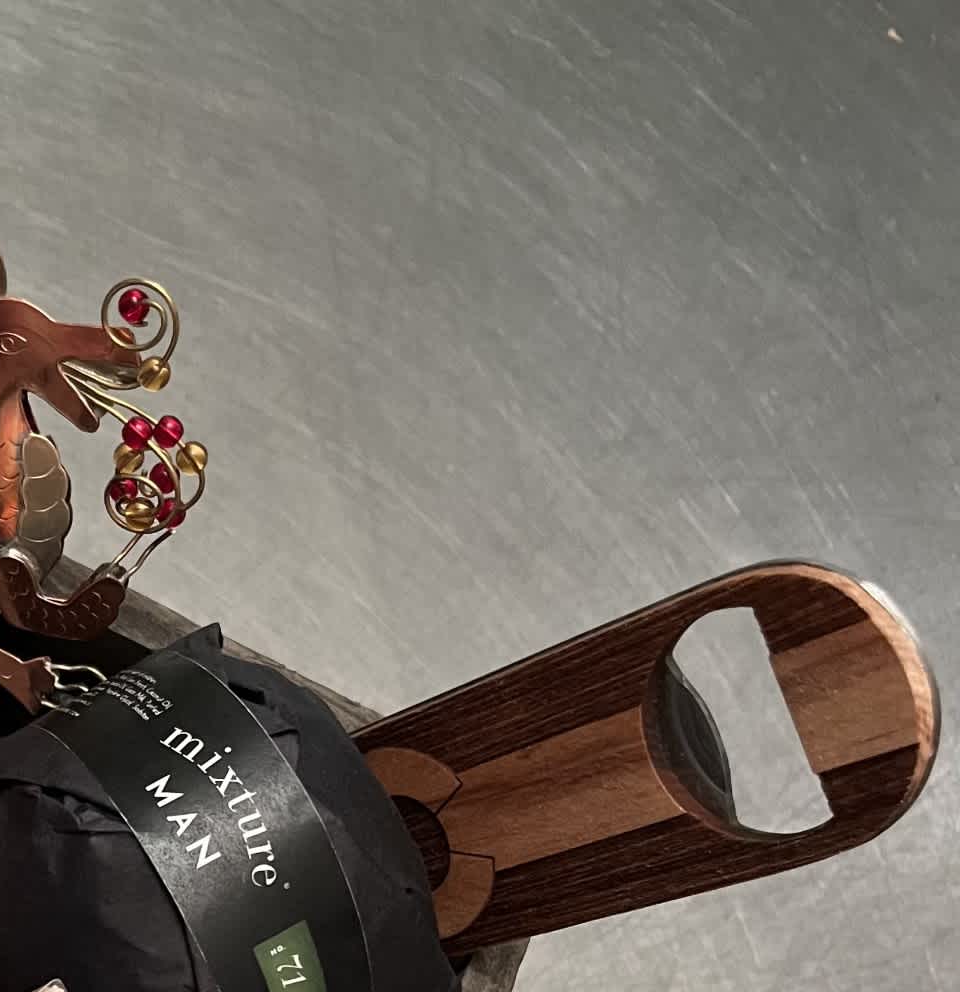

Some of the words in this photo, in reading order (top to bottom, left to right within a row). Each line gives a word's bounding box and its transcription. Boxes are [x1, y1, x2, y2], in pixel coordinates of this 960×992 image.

[145, 774, 222, 870] MAN
[160, 727, 277, 887] mixture
[276, 954, 307, 989] 71
